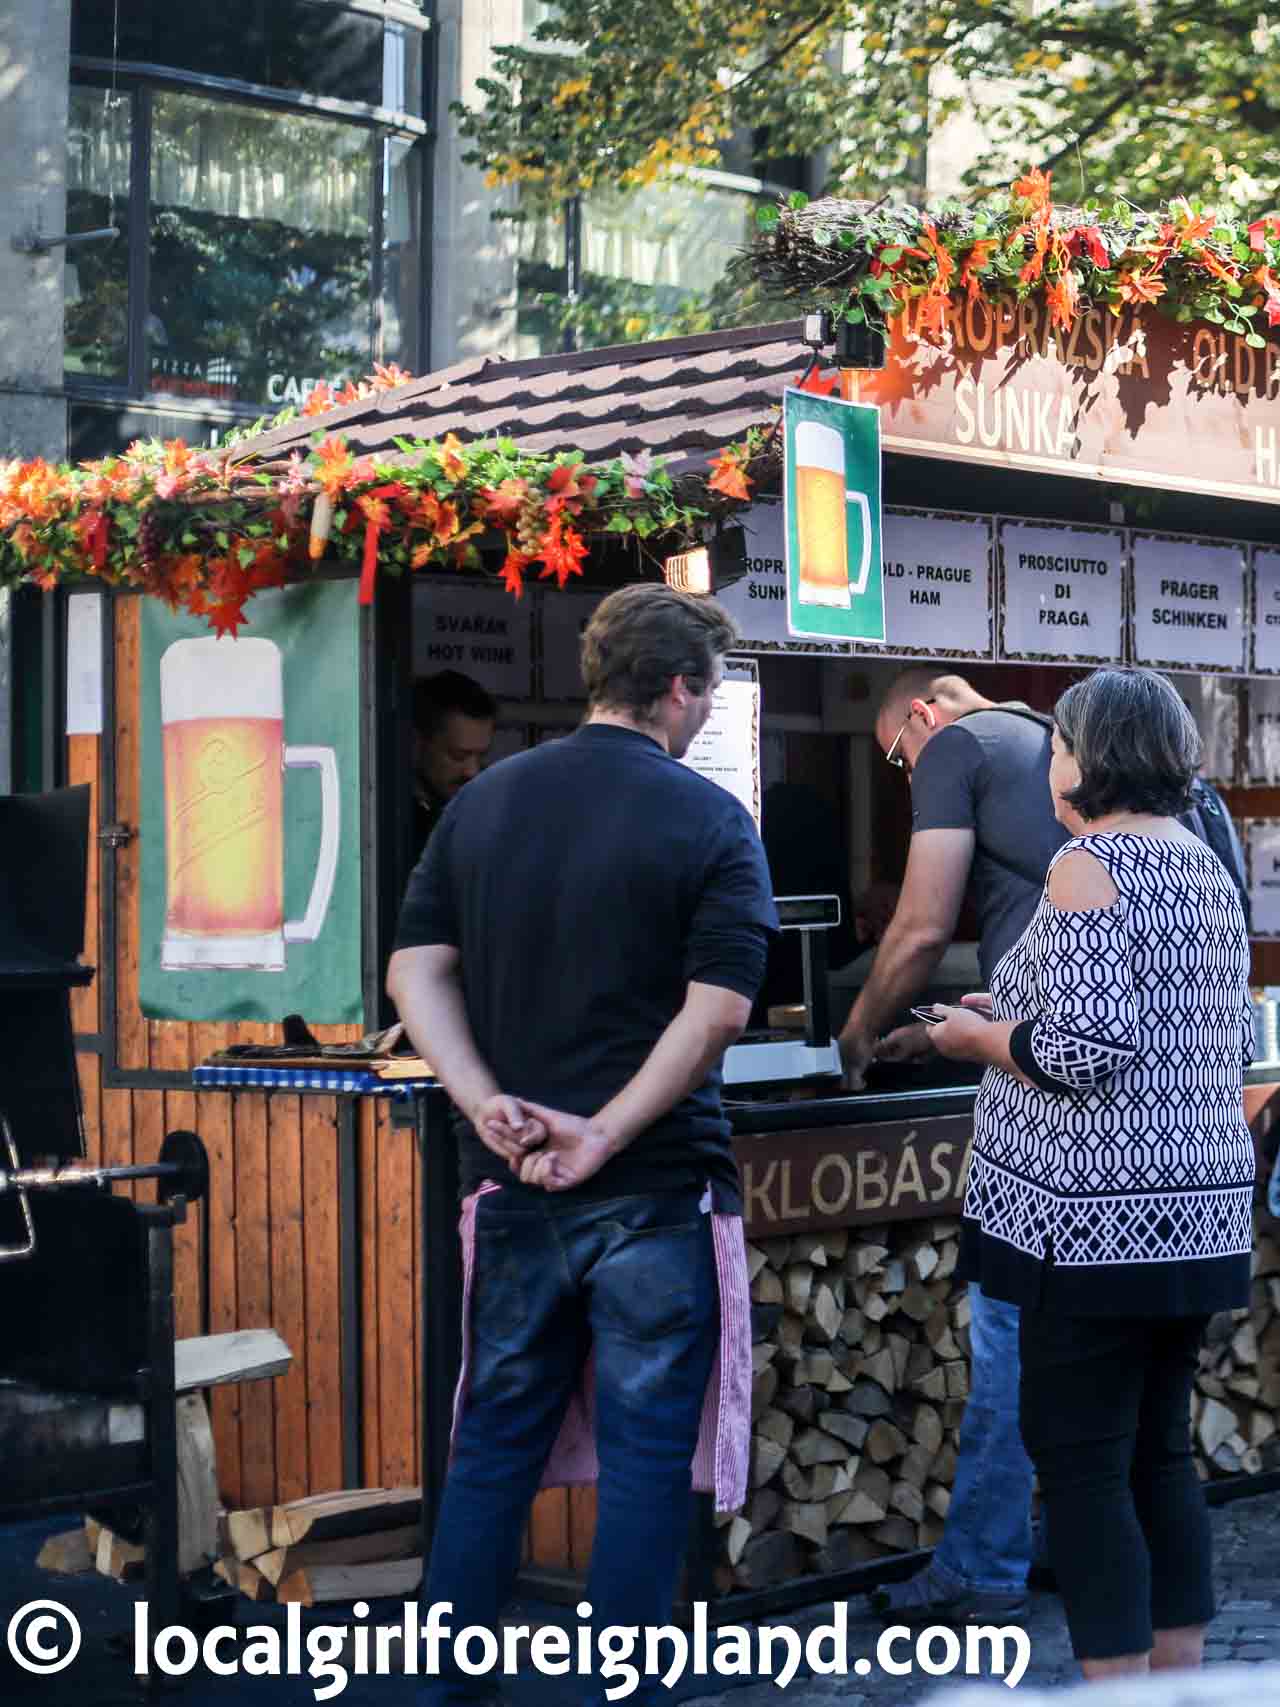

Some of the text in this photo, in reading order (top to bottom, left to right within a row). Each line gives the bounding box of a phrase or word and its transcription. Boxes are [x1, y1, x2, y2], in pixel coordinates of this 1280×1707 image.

[1193, 328, 1256, 393] OLD
[955, 361, 1077, 455] ŠUNKA
[917, 564, 972, 584] PRAGUE
[1019, 554, 1108, 576] PROSCIUTTO
[910, 589, 941, 607] HAM
[1054, 583, 1071, 599] DI
[1160, 579, 1219, 601] PRAGER
[1039, 610, 1090, 627] PRAGA
[1152, 608, 1228, 630] SCHINKEN
